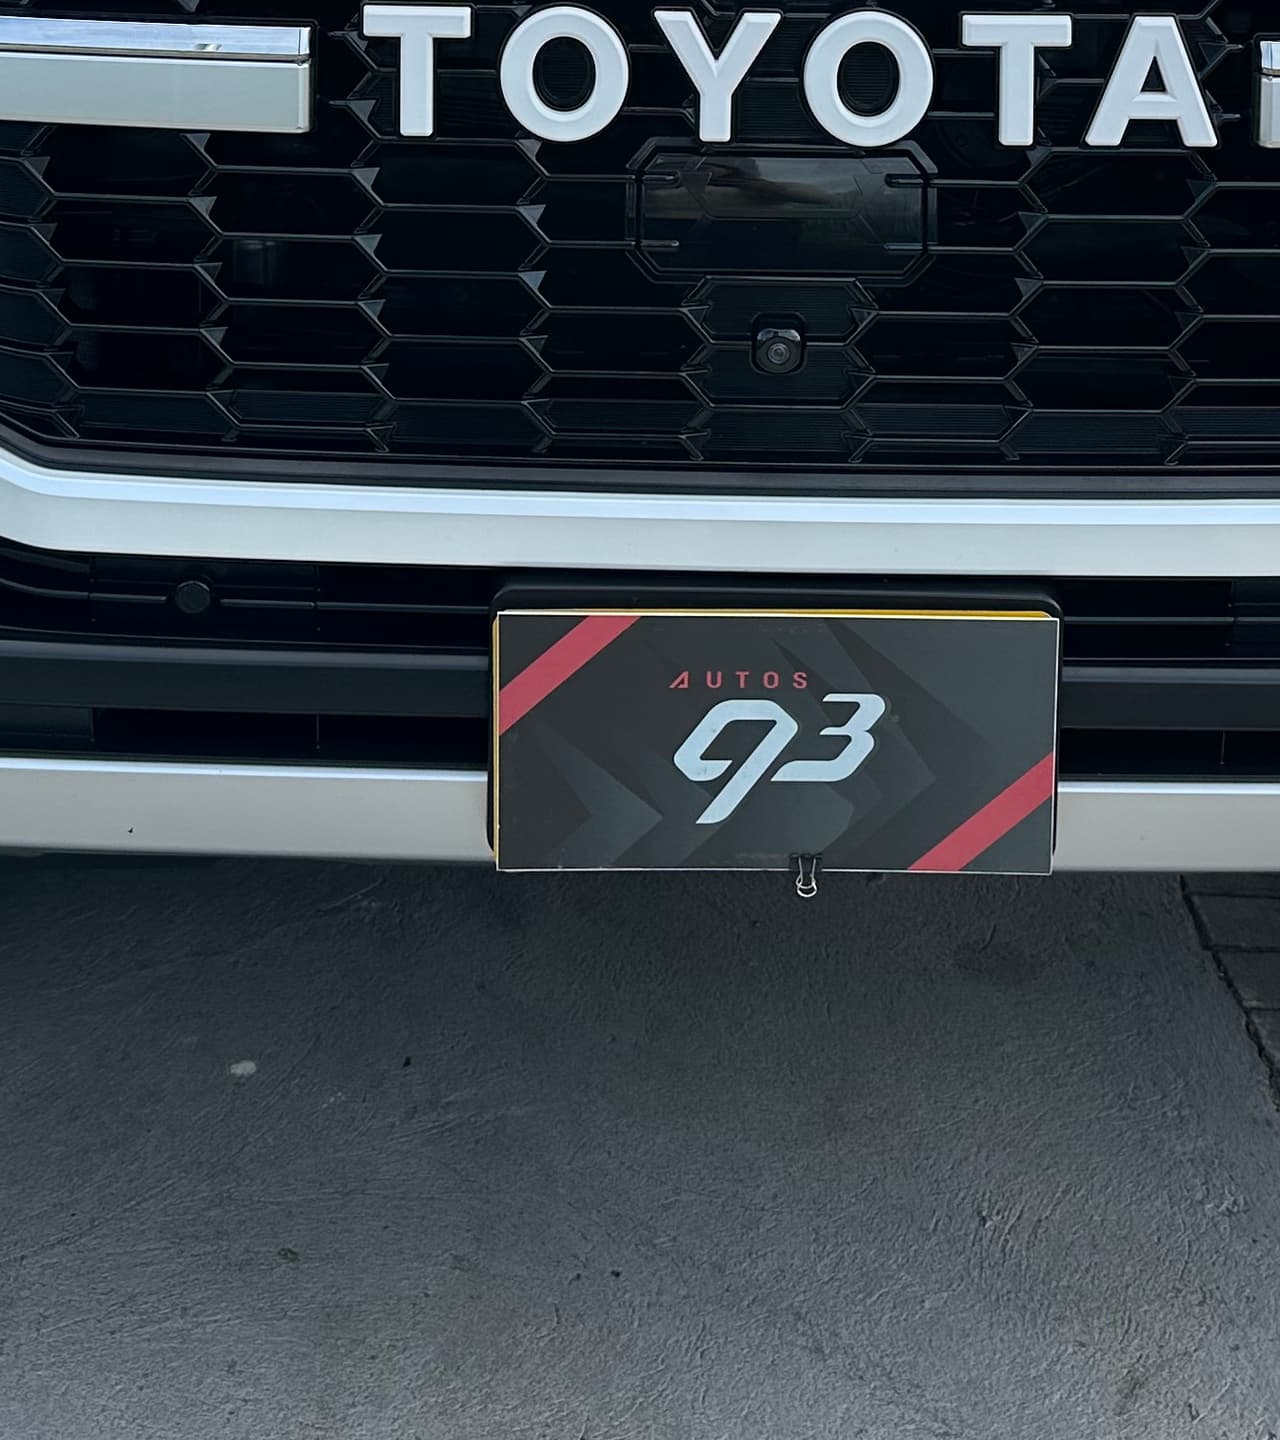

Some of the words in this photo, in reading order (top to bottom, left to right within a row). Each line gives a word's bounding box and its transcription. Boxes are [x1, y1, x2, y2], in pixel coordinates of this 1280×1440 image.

[362, 4, 1218, 148] TOYOTA
[668, 670, 809, 690] AUTOS
[673, 692, 887, 824] 93
